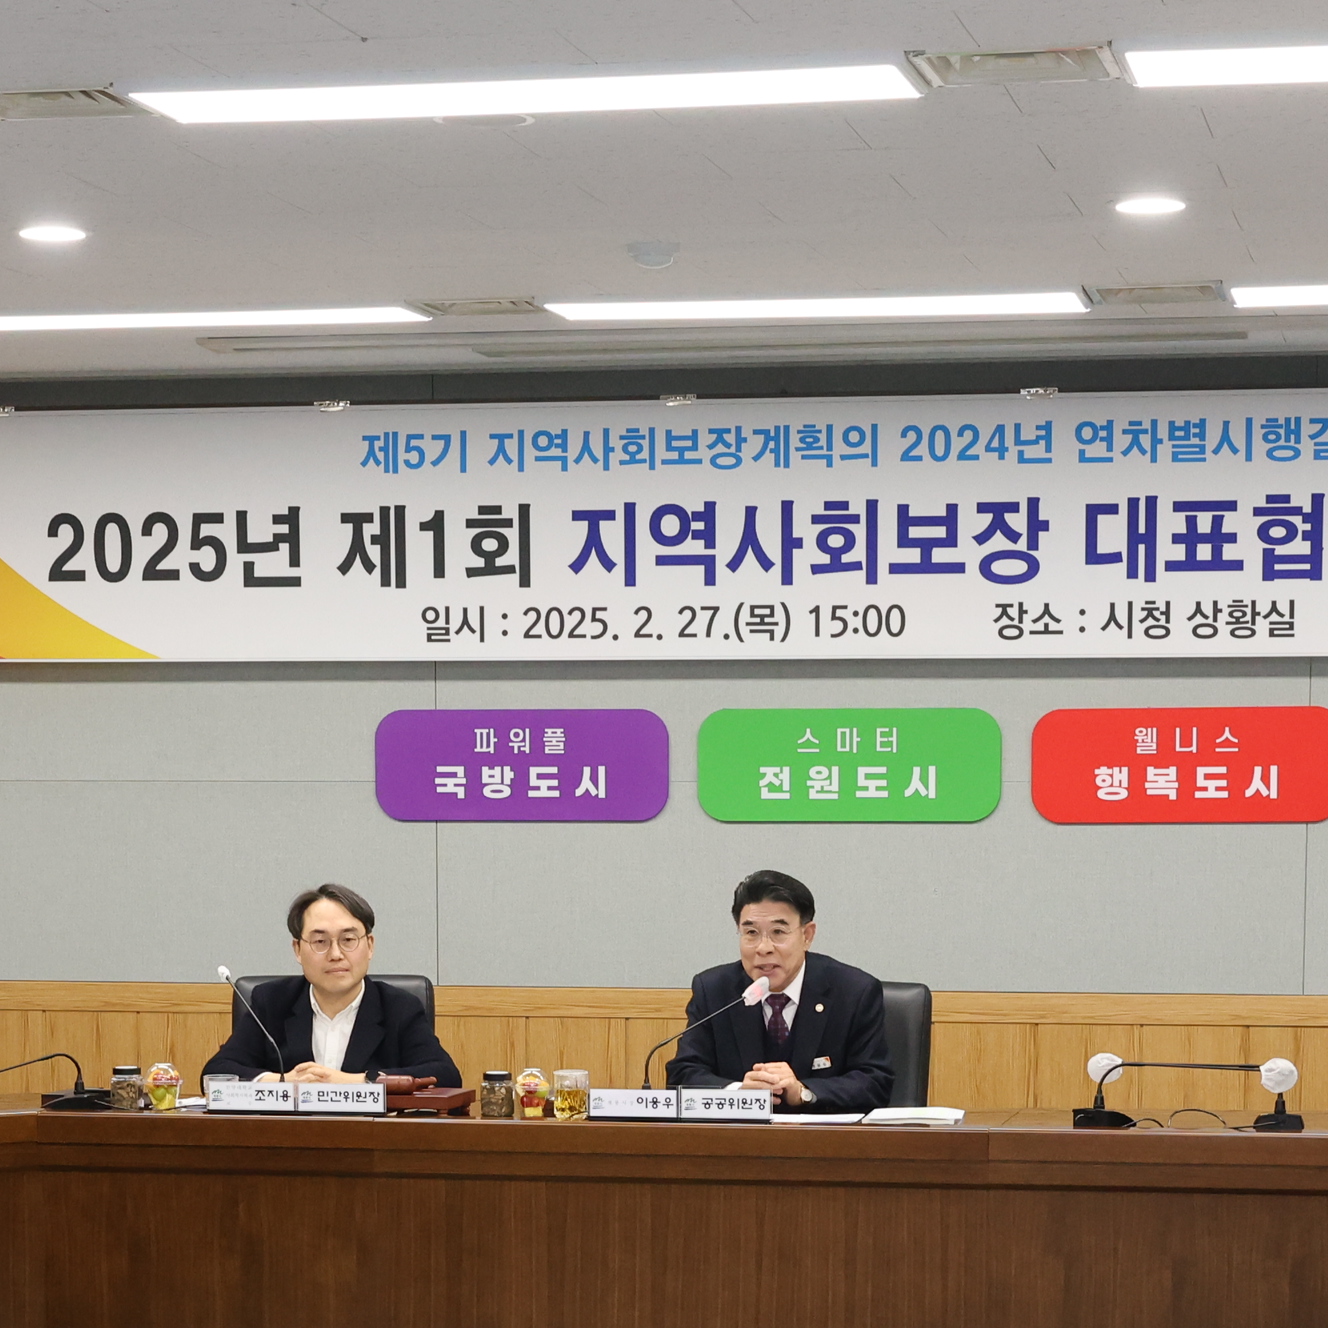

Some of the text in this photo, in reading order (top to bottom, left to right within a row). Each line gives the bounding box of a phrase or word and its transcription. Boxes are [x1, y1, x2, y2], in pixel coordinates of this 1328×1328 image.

[361, 431, 467, 474] 제5기
[489, 424, 878, 472] 지역사회보장계획의
[901, 421, 1052, 464] 2024년
[48, 506, 301, 587] 2025년
[337, 504, 530, 588] 제1회
[568, 497, 1049, 587] 지역사회보장
[422, 606, 484, 642] 일시
[523, 607, 618, 641] 2025.
[809, 604, 905, 638] 15:00
[993, 602, 1063, 640] 장소
[1101, 601, 1170, 639] 시청
[1187, 600, 1294, 639] 상황실
[475, 729, 565, 753] 파워풀
[798, 728, 896, 753] 스마터
[1135, 727, 1238, 753] 웰니스
[435, 766, 605, 798] 국방도시
[759, 766, 935, 799] 전원도시
[1095, 766, 1277, 800] 행복도시
[254, 1089, 292, 1103] 조지용
[317, 1090, 381, 1104] 민간위원장
[701, 1097, 767, 1111] 공공위원장
